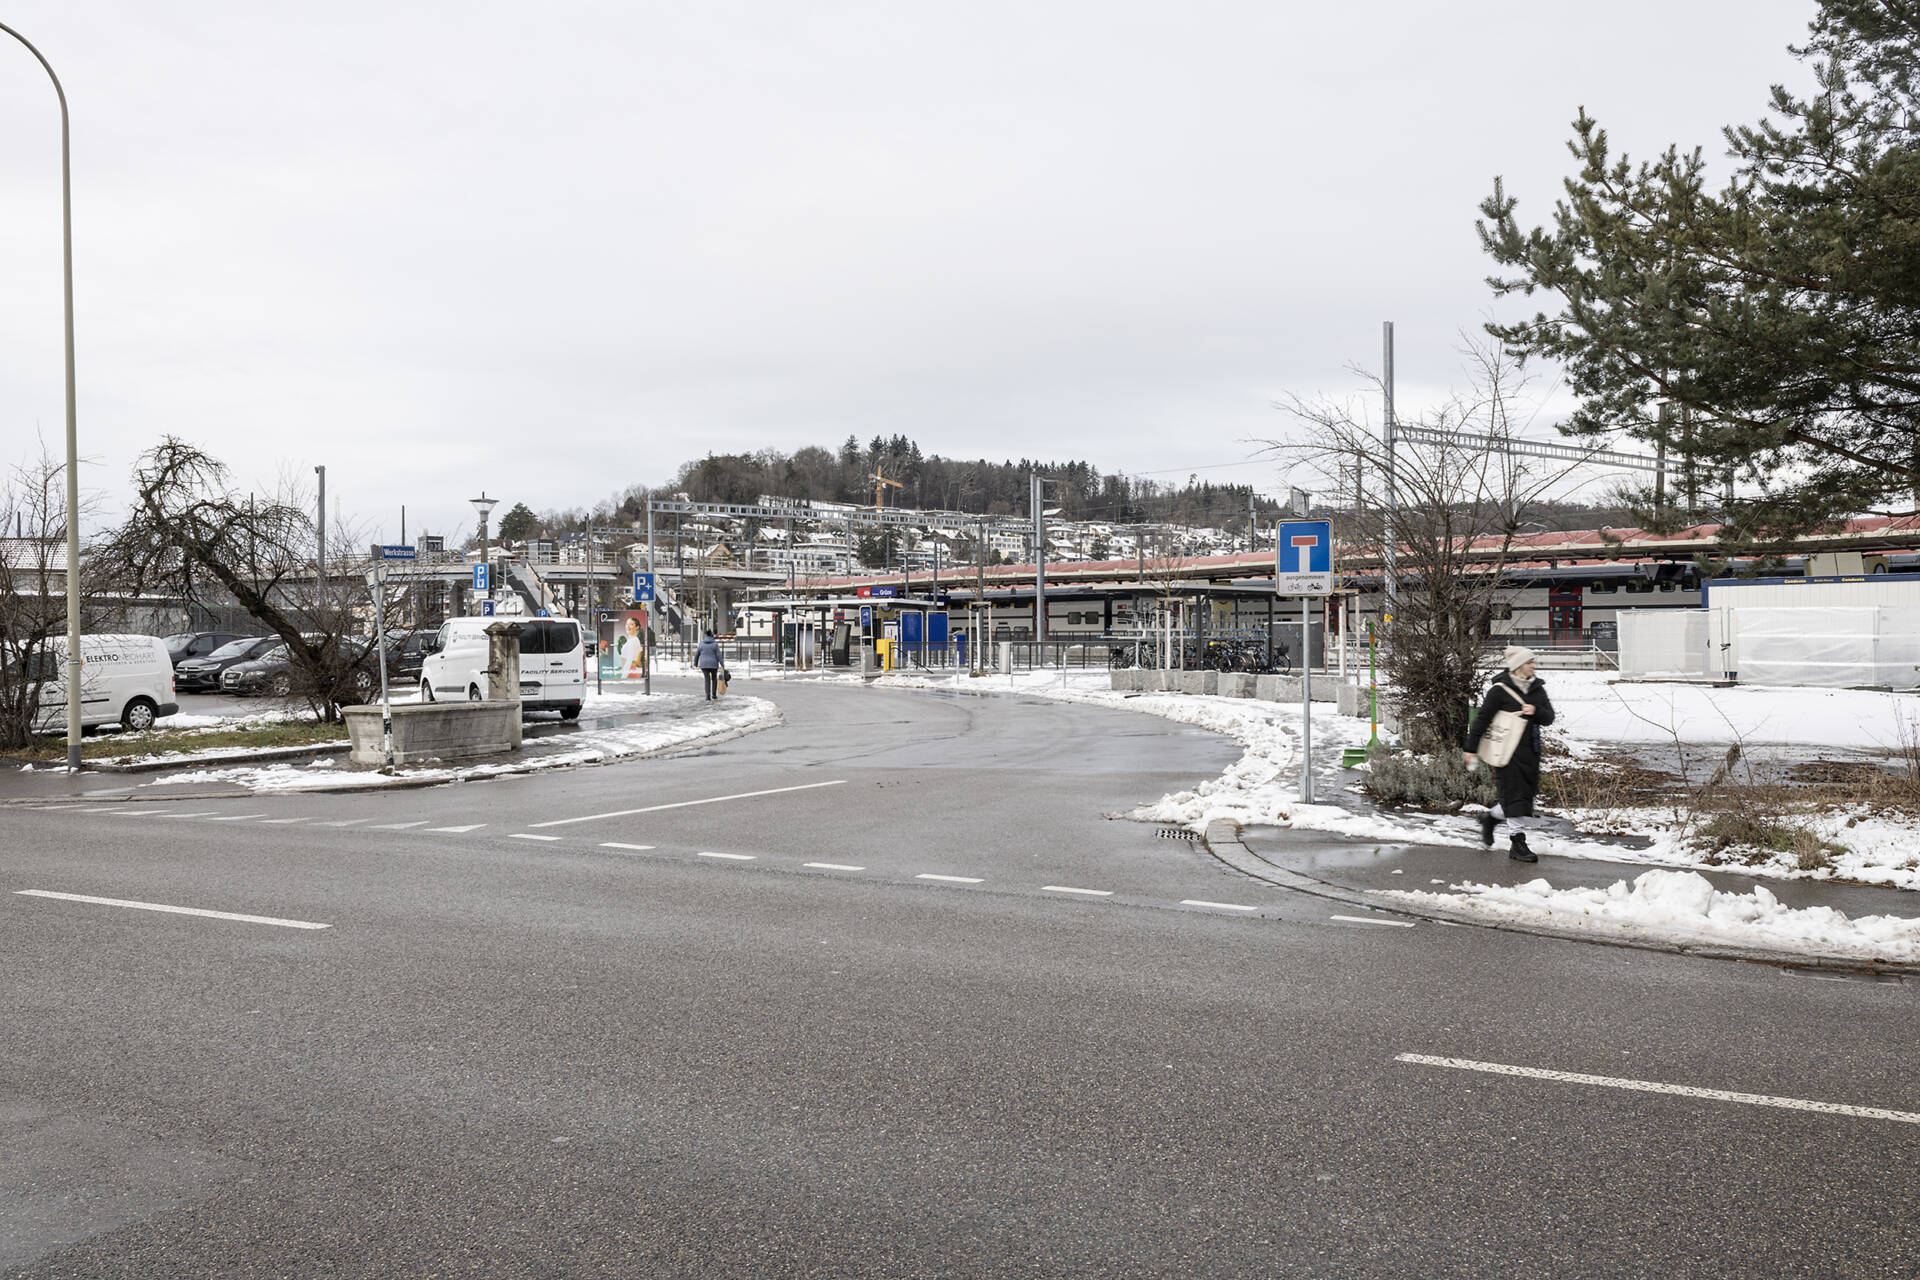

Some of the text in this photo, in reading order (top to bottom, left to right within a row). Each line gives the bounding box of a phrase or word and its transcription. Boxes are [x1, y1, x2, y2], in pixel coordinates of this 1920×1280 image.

[477, 567, 484, 578] P
[484, 606, 490, 614] P
[86, 654, 119, 663] ELEKTRO
